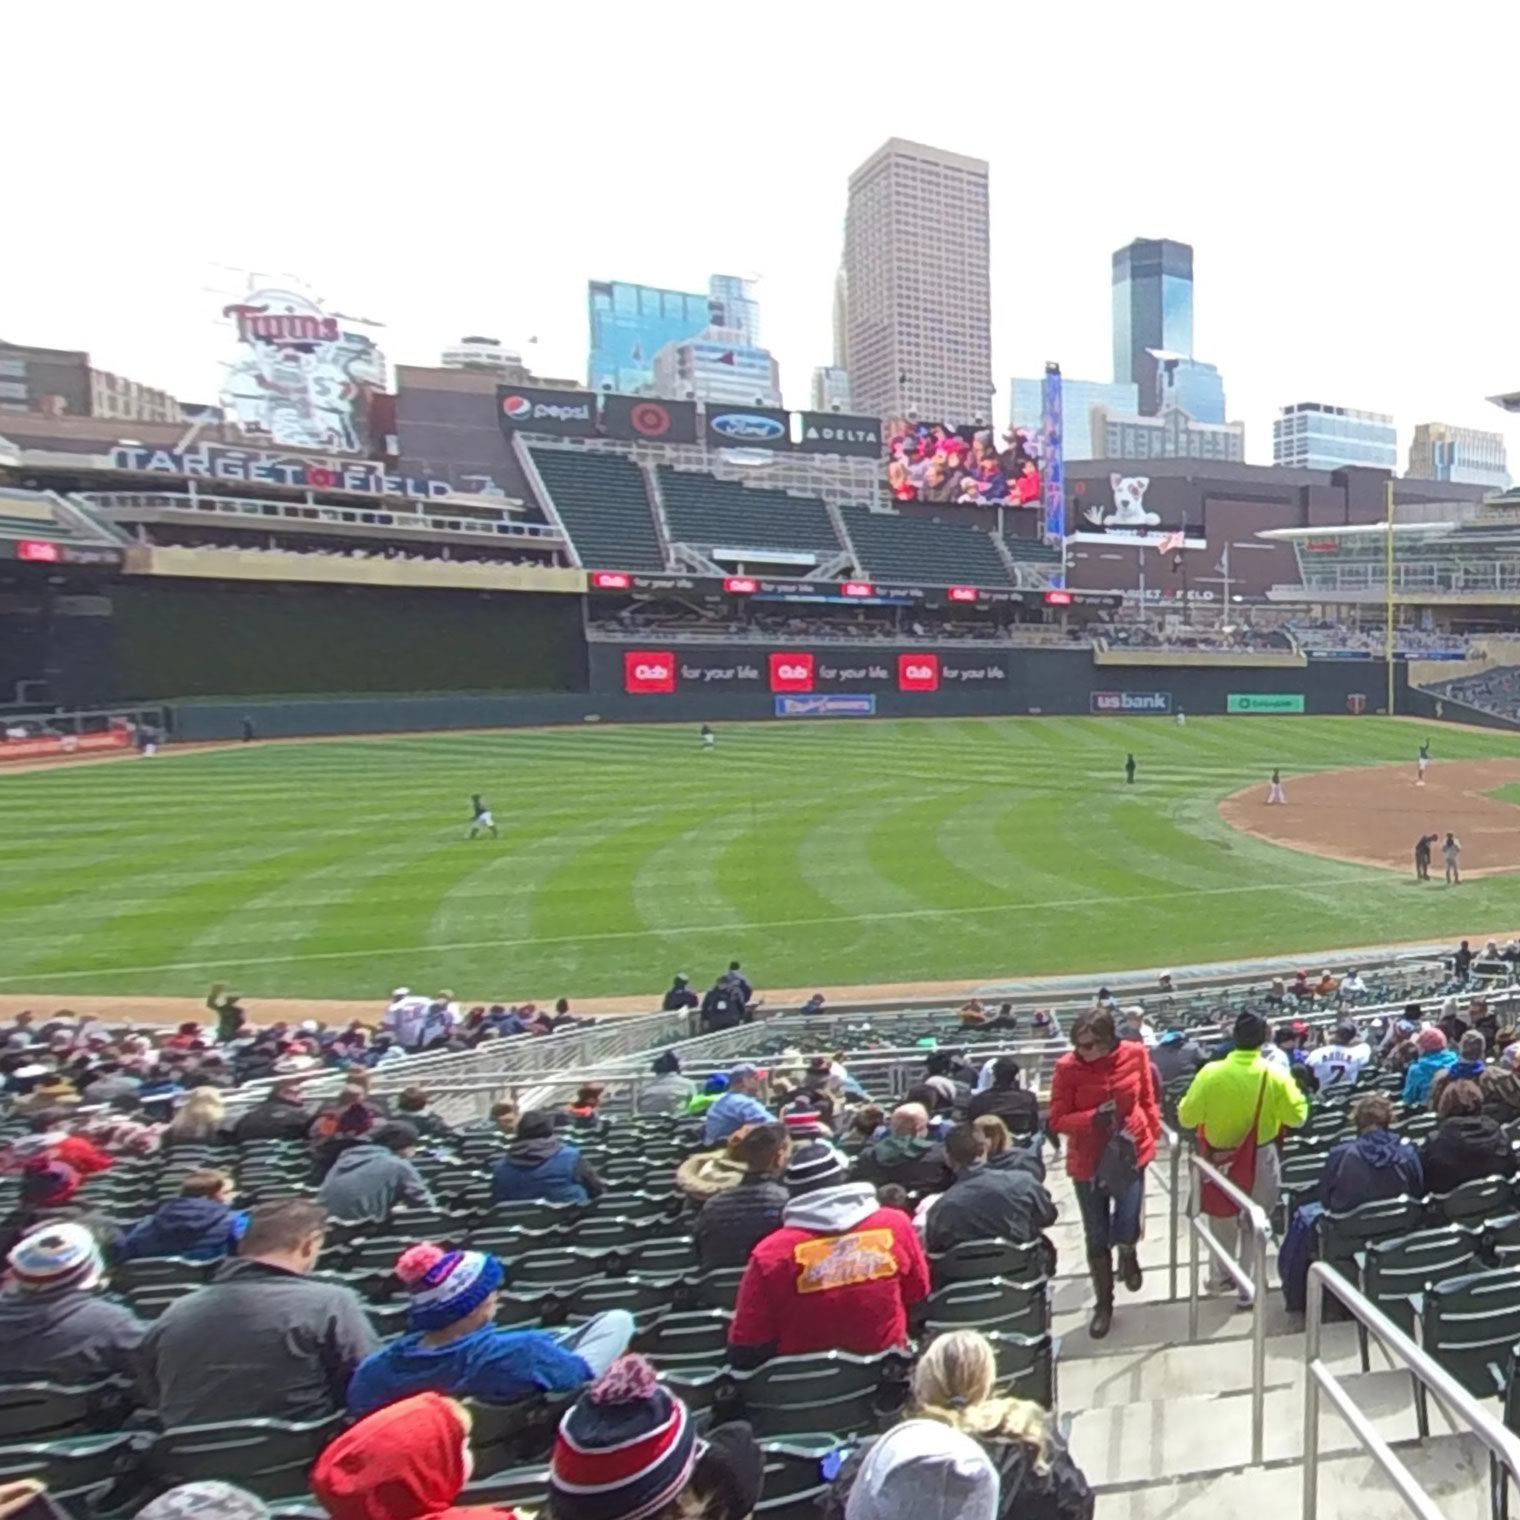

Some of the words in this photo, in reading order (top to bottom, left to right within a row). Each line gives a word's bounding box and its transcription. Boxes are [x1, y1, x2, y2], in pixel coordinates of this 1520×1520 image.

[223, 304, 338, 343] Twins
[533, 404, 590, 421] pepsi
[725, 418, 772, 437] Ford
[821, 428, 877, 443] DELTA
[117, 448, 306, 487] TARGET
[343, 470, 454, 498] FIELD
[681, 664, 701, 679] for
[703, 668, 735, 682] your
[819, 665, 837, 679] for
[839, 668, 867, 682] your
[943, 666, 959, 679] for
[960, 669, 986, 681] your
[1330, 1065, 1345, 1084] 7
